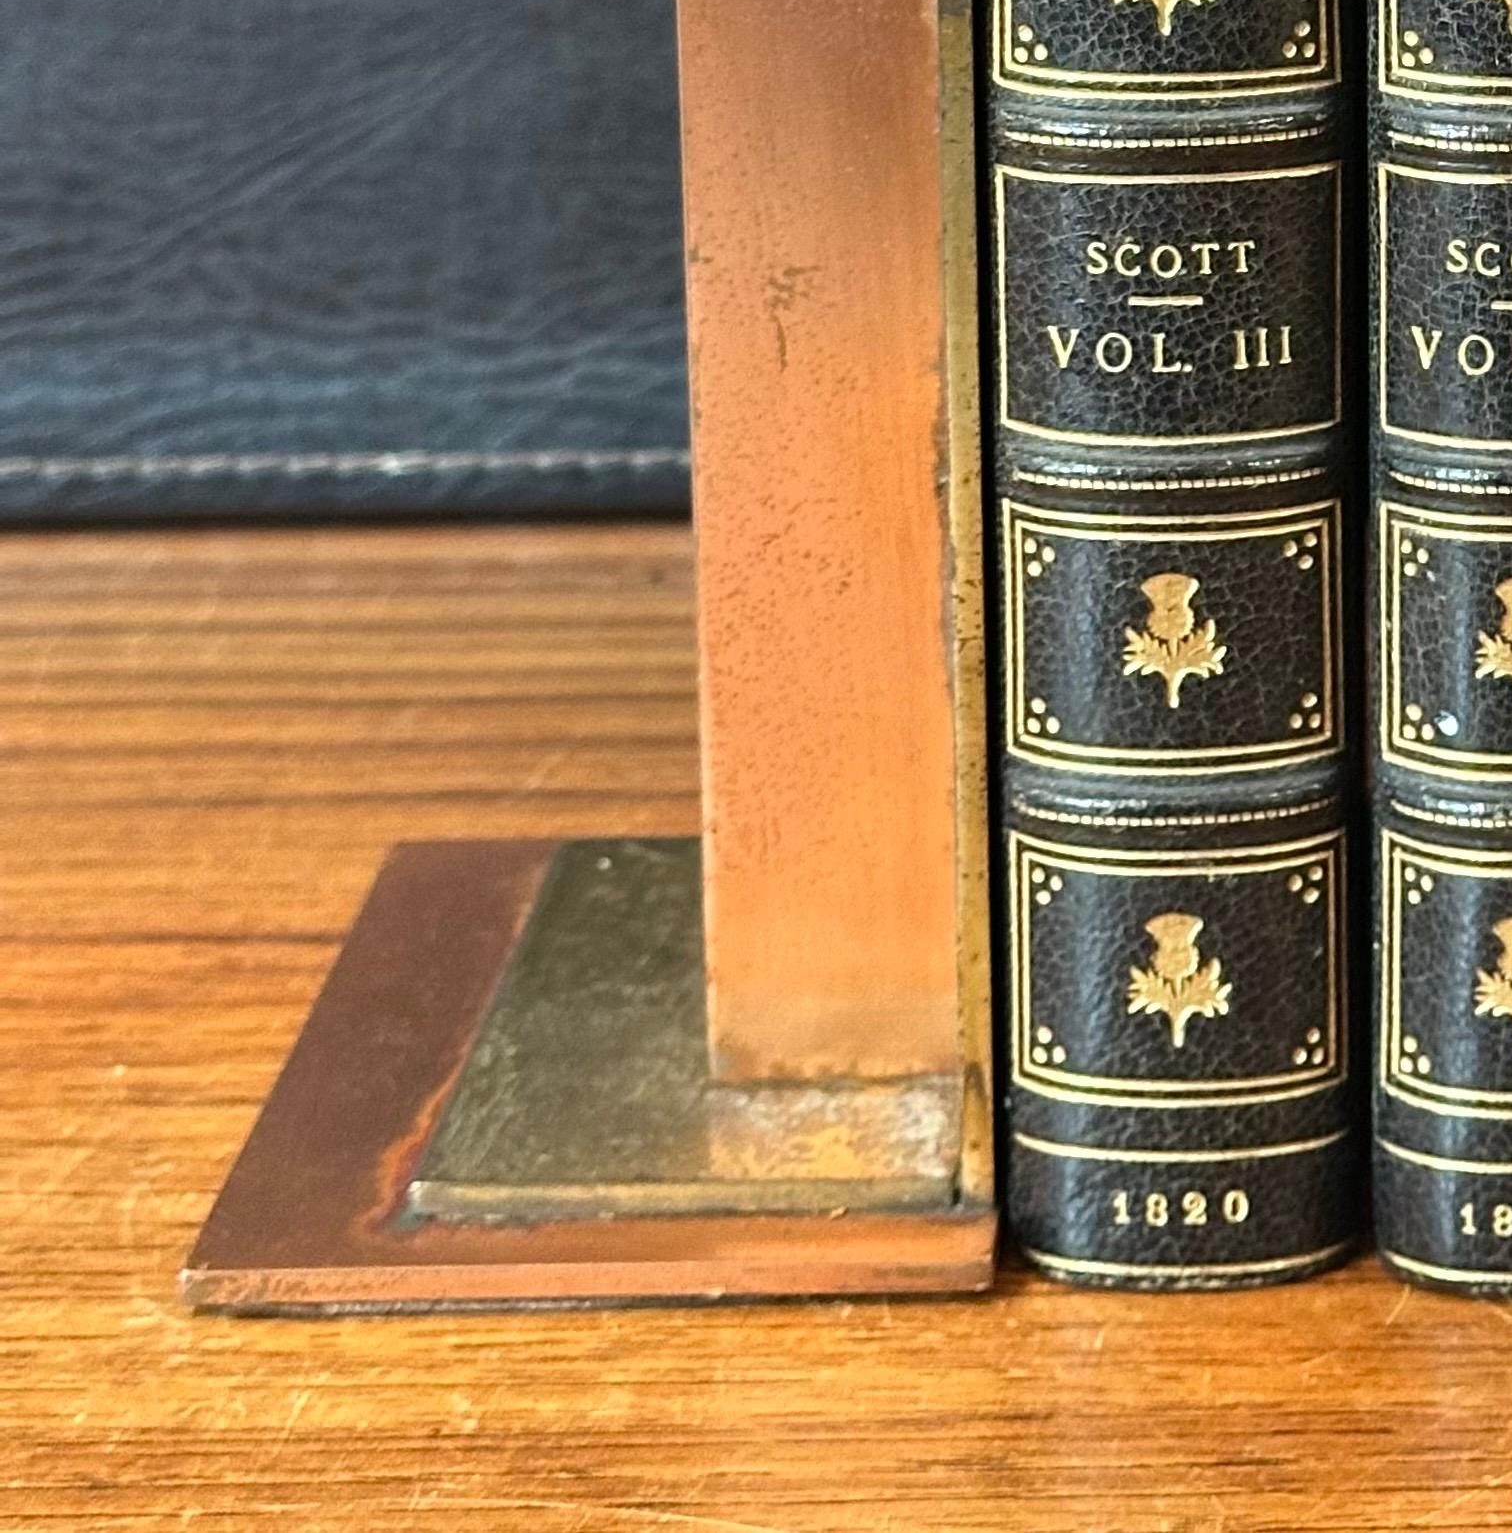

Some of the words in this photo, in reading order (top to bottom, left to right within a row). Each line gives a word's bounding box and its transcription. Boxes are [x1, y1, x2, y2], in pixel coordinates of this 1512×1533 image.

[1086, 240, 1256, 278] SCOTT
[1047, 325, 1193, 374] VOL.
[1233, 326, 1293, 370] III
[1112, 1189, 1250, 1227] 1820
